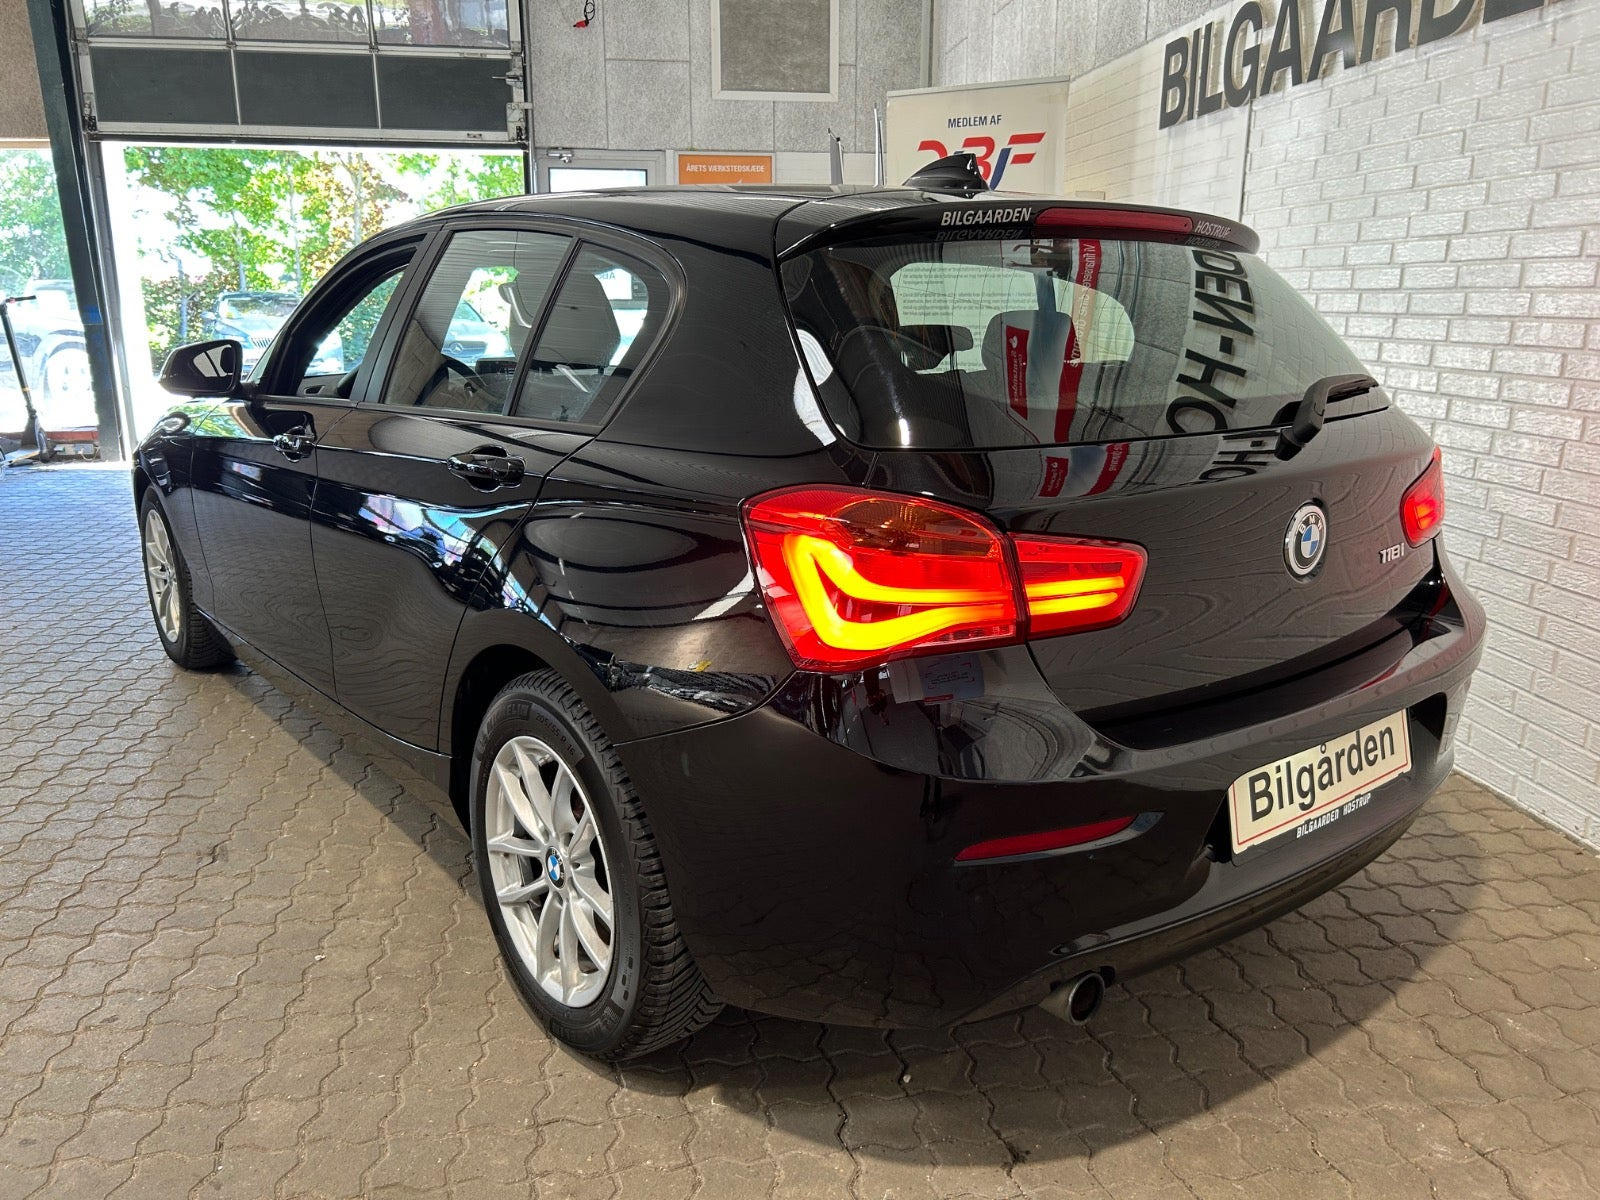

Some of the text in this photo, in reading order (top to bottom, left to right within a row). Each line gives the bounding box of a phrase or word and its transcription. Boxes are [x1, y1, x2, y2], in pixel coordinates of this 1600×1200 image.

[1159, 0, 1546, 130] BILGAAR
[947, 115, 1003, 129] MEDLEM AF
[686, 162, 765, 173] ÅRETS VÆRKSTEDSKÆDE
[940, 207, 1032, 226] BILGAARDEN
[1248, 726, 1396, 822] Bilgården
[1296, 792, 1371, 839] BILGAARDEN HOSTRUP
